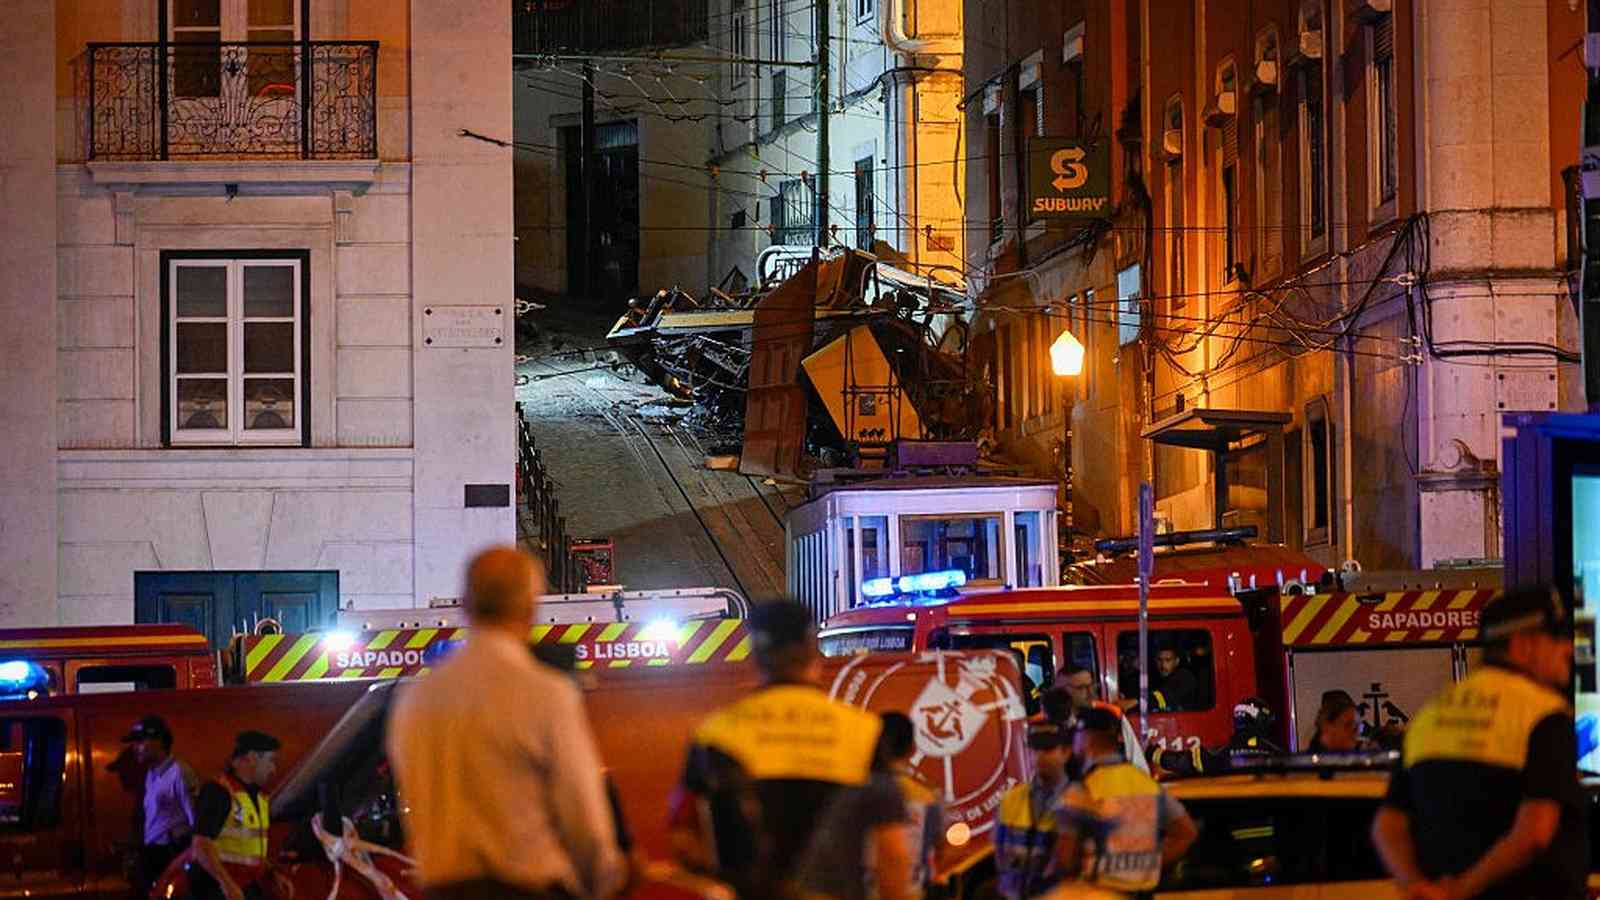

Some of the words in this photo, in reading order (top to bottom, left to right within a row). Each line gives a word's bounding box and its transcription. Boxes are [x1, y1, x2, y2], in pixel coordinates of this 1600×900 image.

[1032, 197, 1105, 212] SUBWAY
[1368, 610, 1482, 630] SAPADORES
[594, 641, 669, 659] LISBOA
